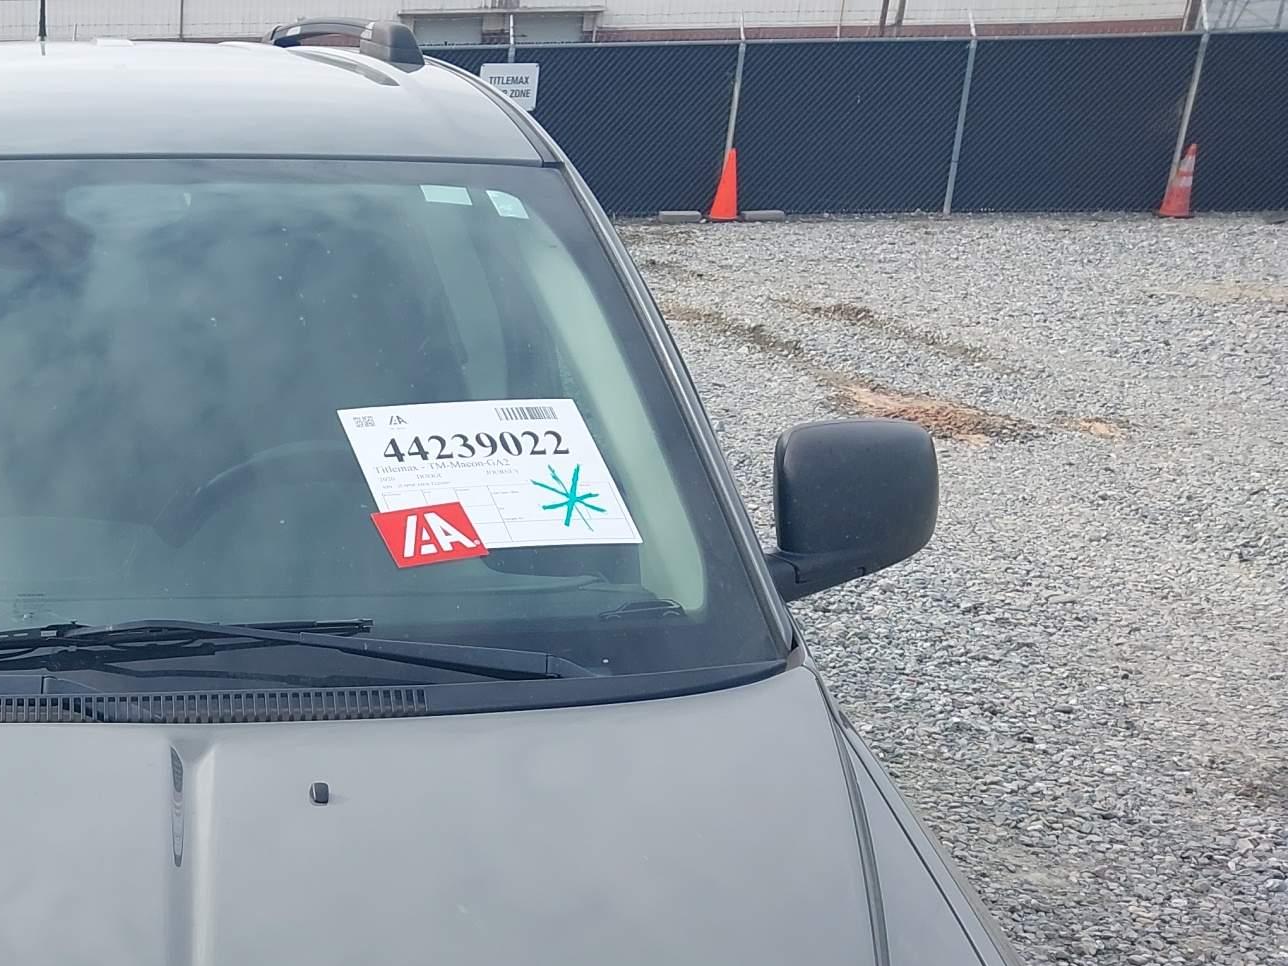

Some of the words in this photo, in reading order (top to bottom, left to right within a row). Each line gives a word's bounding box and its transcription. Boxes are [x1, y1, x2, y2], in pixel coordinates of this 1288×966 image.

[488, 75, 530, 85] TITLEMAX
[509, 89, 531, 98] ZONE
[383, 430, 570, 463] 44239022
[376, 463, 418, 474] Titlemax
